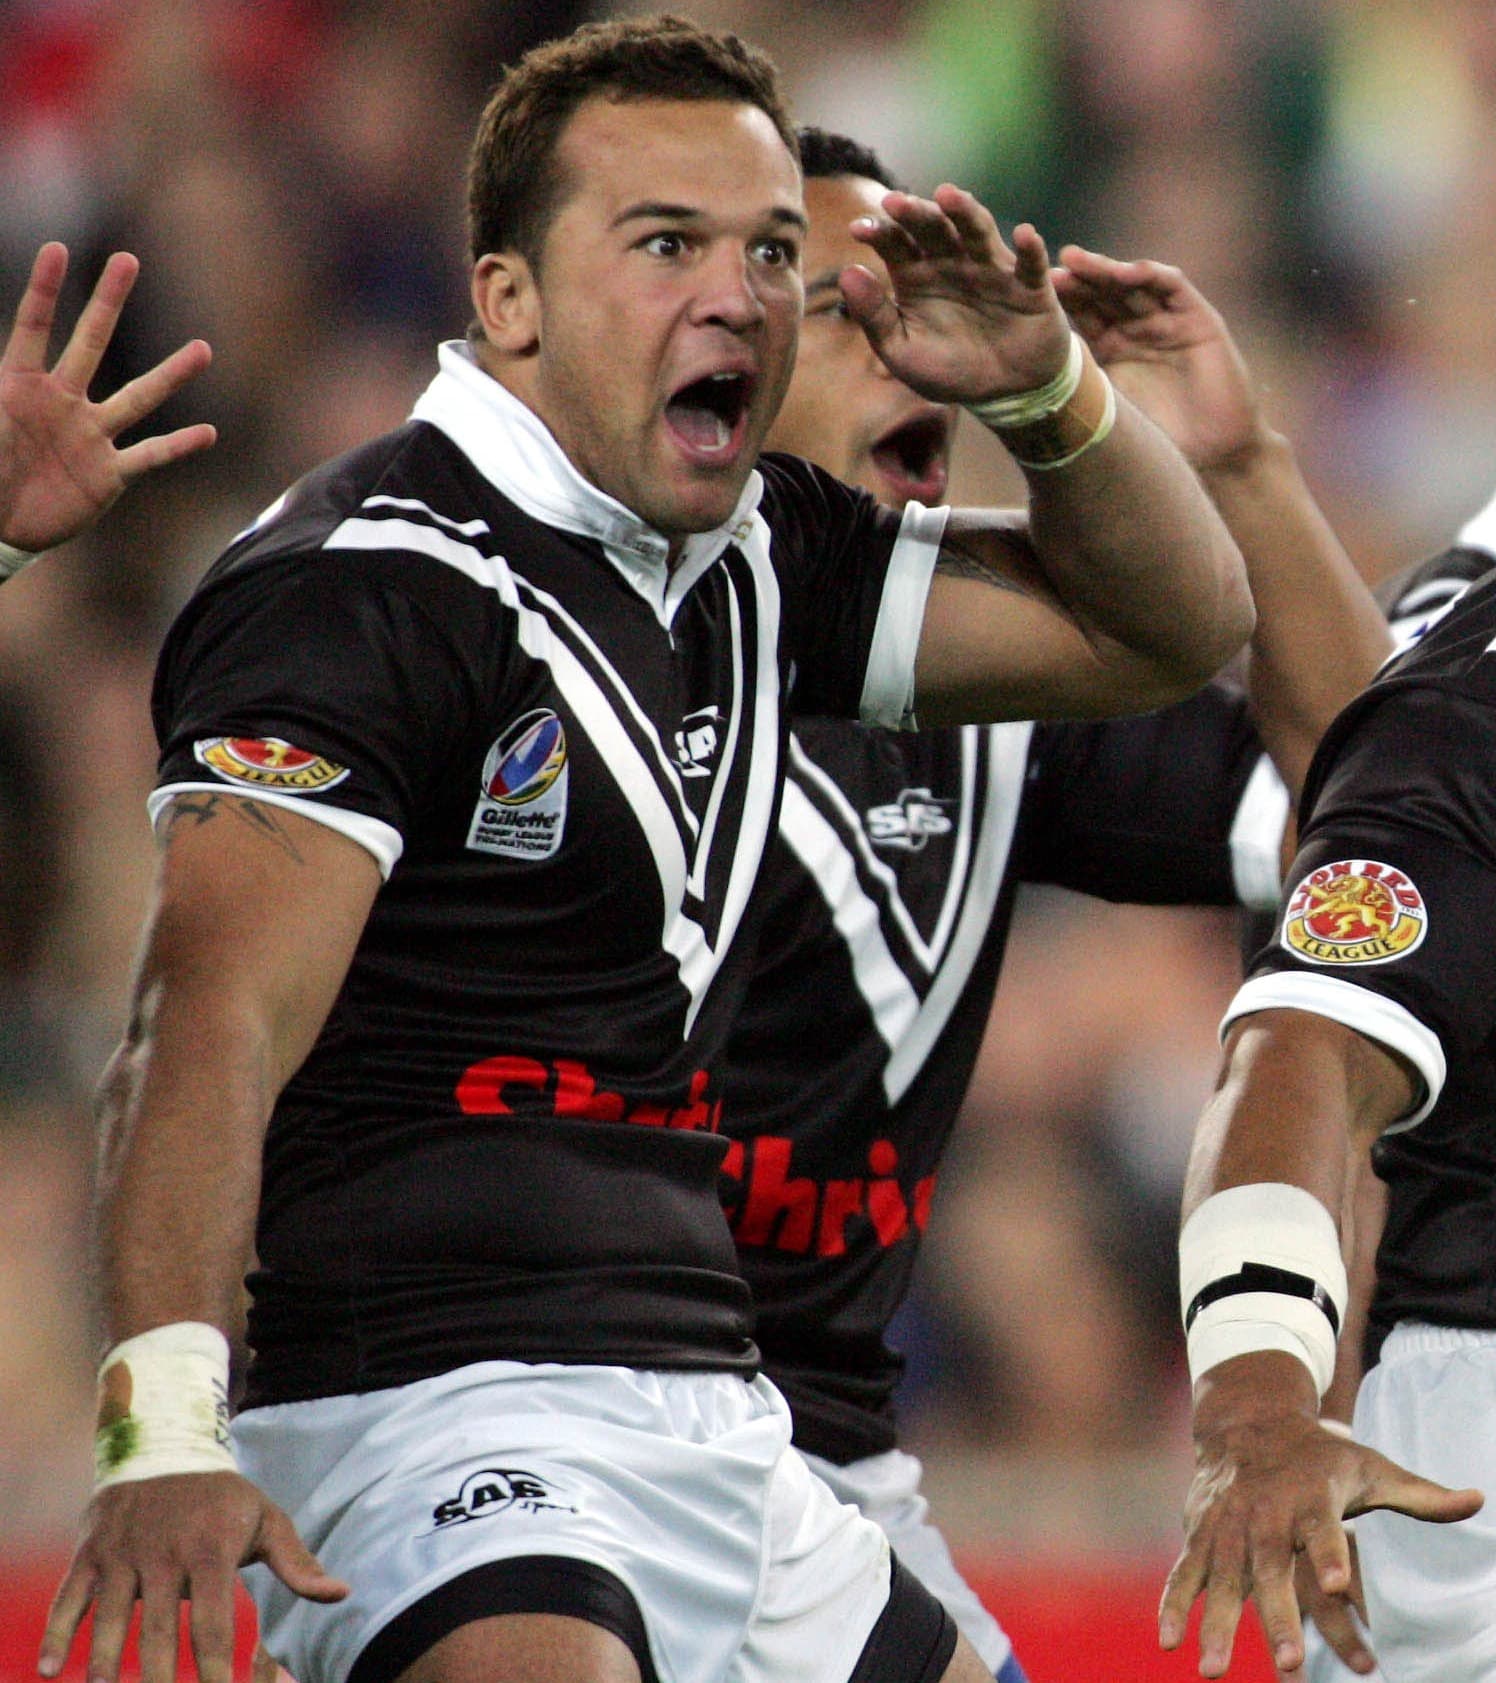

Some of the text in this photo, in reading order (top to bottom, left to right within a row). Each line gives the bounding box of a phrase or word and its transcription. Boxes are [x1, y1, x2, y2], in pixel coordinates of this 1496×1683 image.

[1361, 863, 1422, 908] RED
[1302, 938, 1396, 960] LEAGUE
[433, 1480, 548, 1526] SAS
